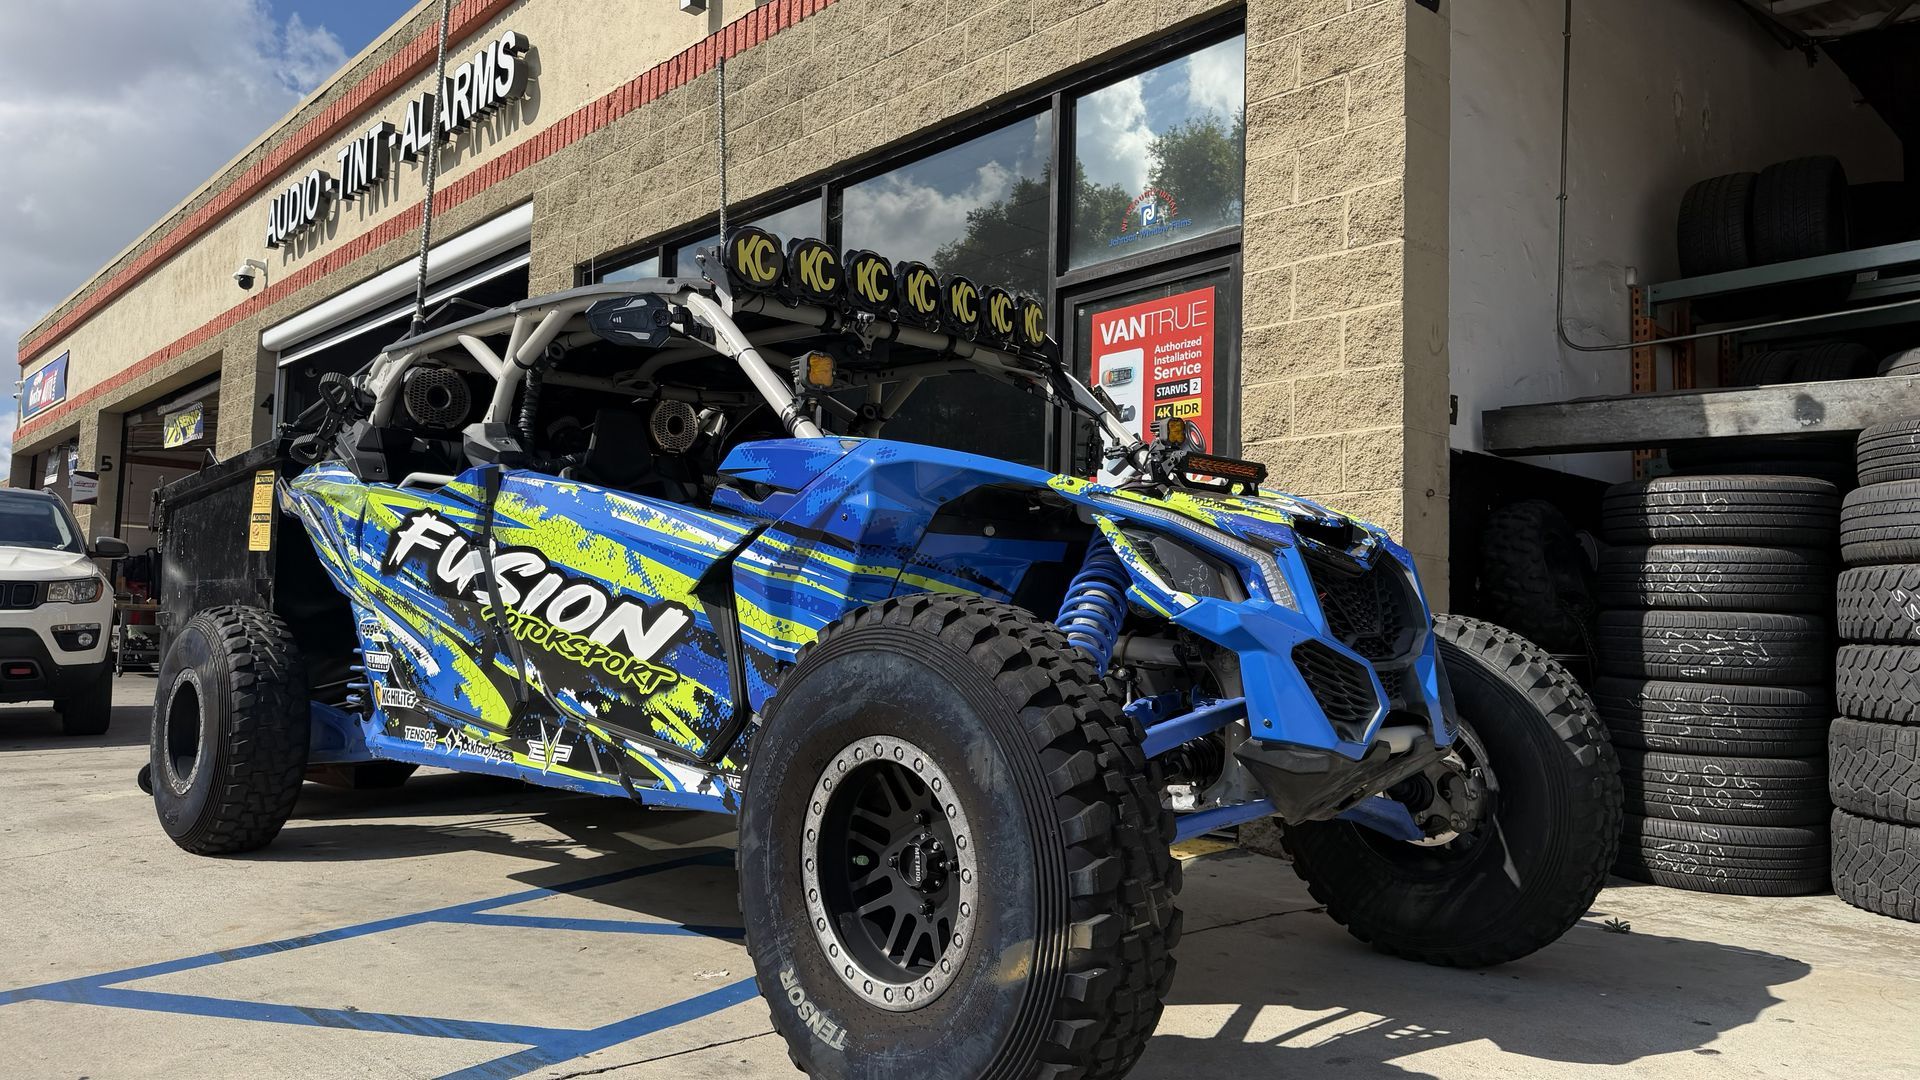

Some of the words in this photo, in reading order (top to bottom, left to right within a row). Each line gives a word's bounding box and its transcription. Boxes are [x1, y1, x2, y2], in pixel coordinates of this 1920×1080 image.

[266, 169, 320, 248] AUDIO
[338, 121, 385, 200] TINT
[400, 30, 517, 162] ALARMS
[1140, 225, 1169, 239] Window
[1171, 218, 1192, 231] Films
[738, 235, 777, 283] KC
[800, 246, 835, 293] KC
[857, 258, 888, 303] KC
[908, 270, 936, 314] KC
[952, 281, 977, 324] KC
[991, 293, 1013, 334] KC
[1025, 303, 1044, 343] KC
[1100, 300, 1207, 345] VANTRUE
[1154, 336, 1202, 354] Authorized
[1154, 350, 1202, 366] Installation
[1154, 362, 1201, 380] Service
[1156, 383, 1188, 398] STARVIS
[1192, 381, 1199, 392] 2
[1156, 406, 1171, 420] 4K
[1176, 404, 1199, 416] HDR
[100, 456, 113, 472] 5
[389, 512, 689, 661] FUSION
[405, 727, 437, 743] TENSOR
[779, 967, 848, 1052] TENSOR
